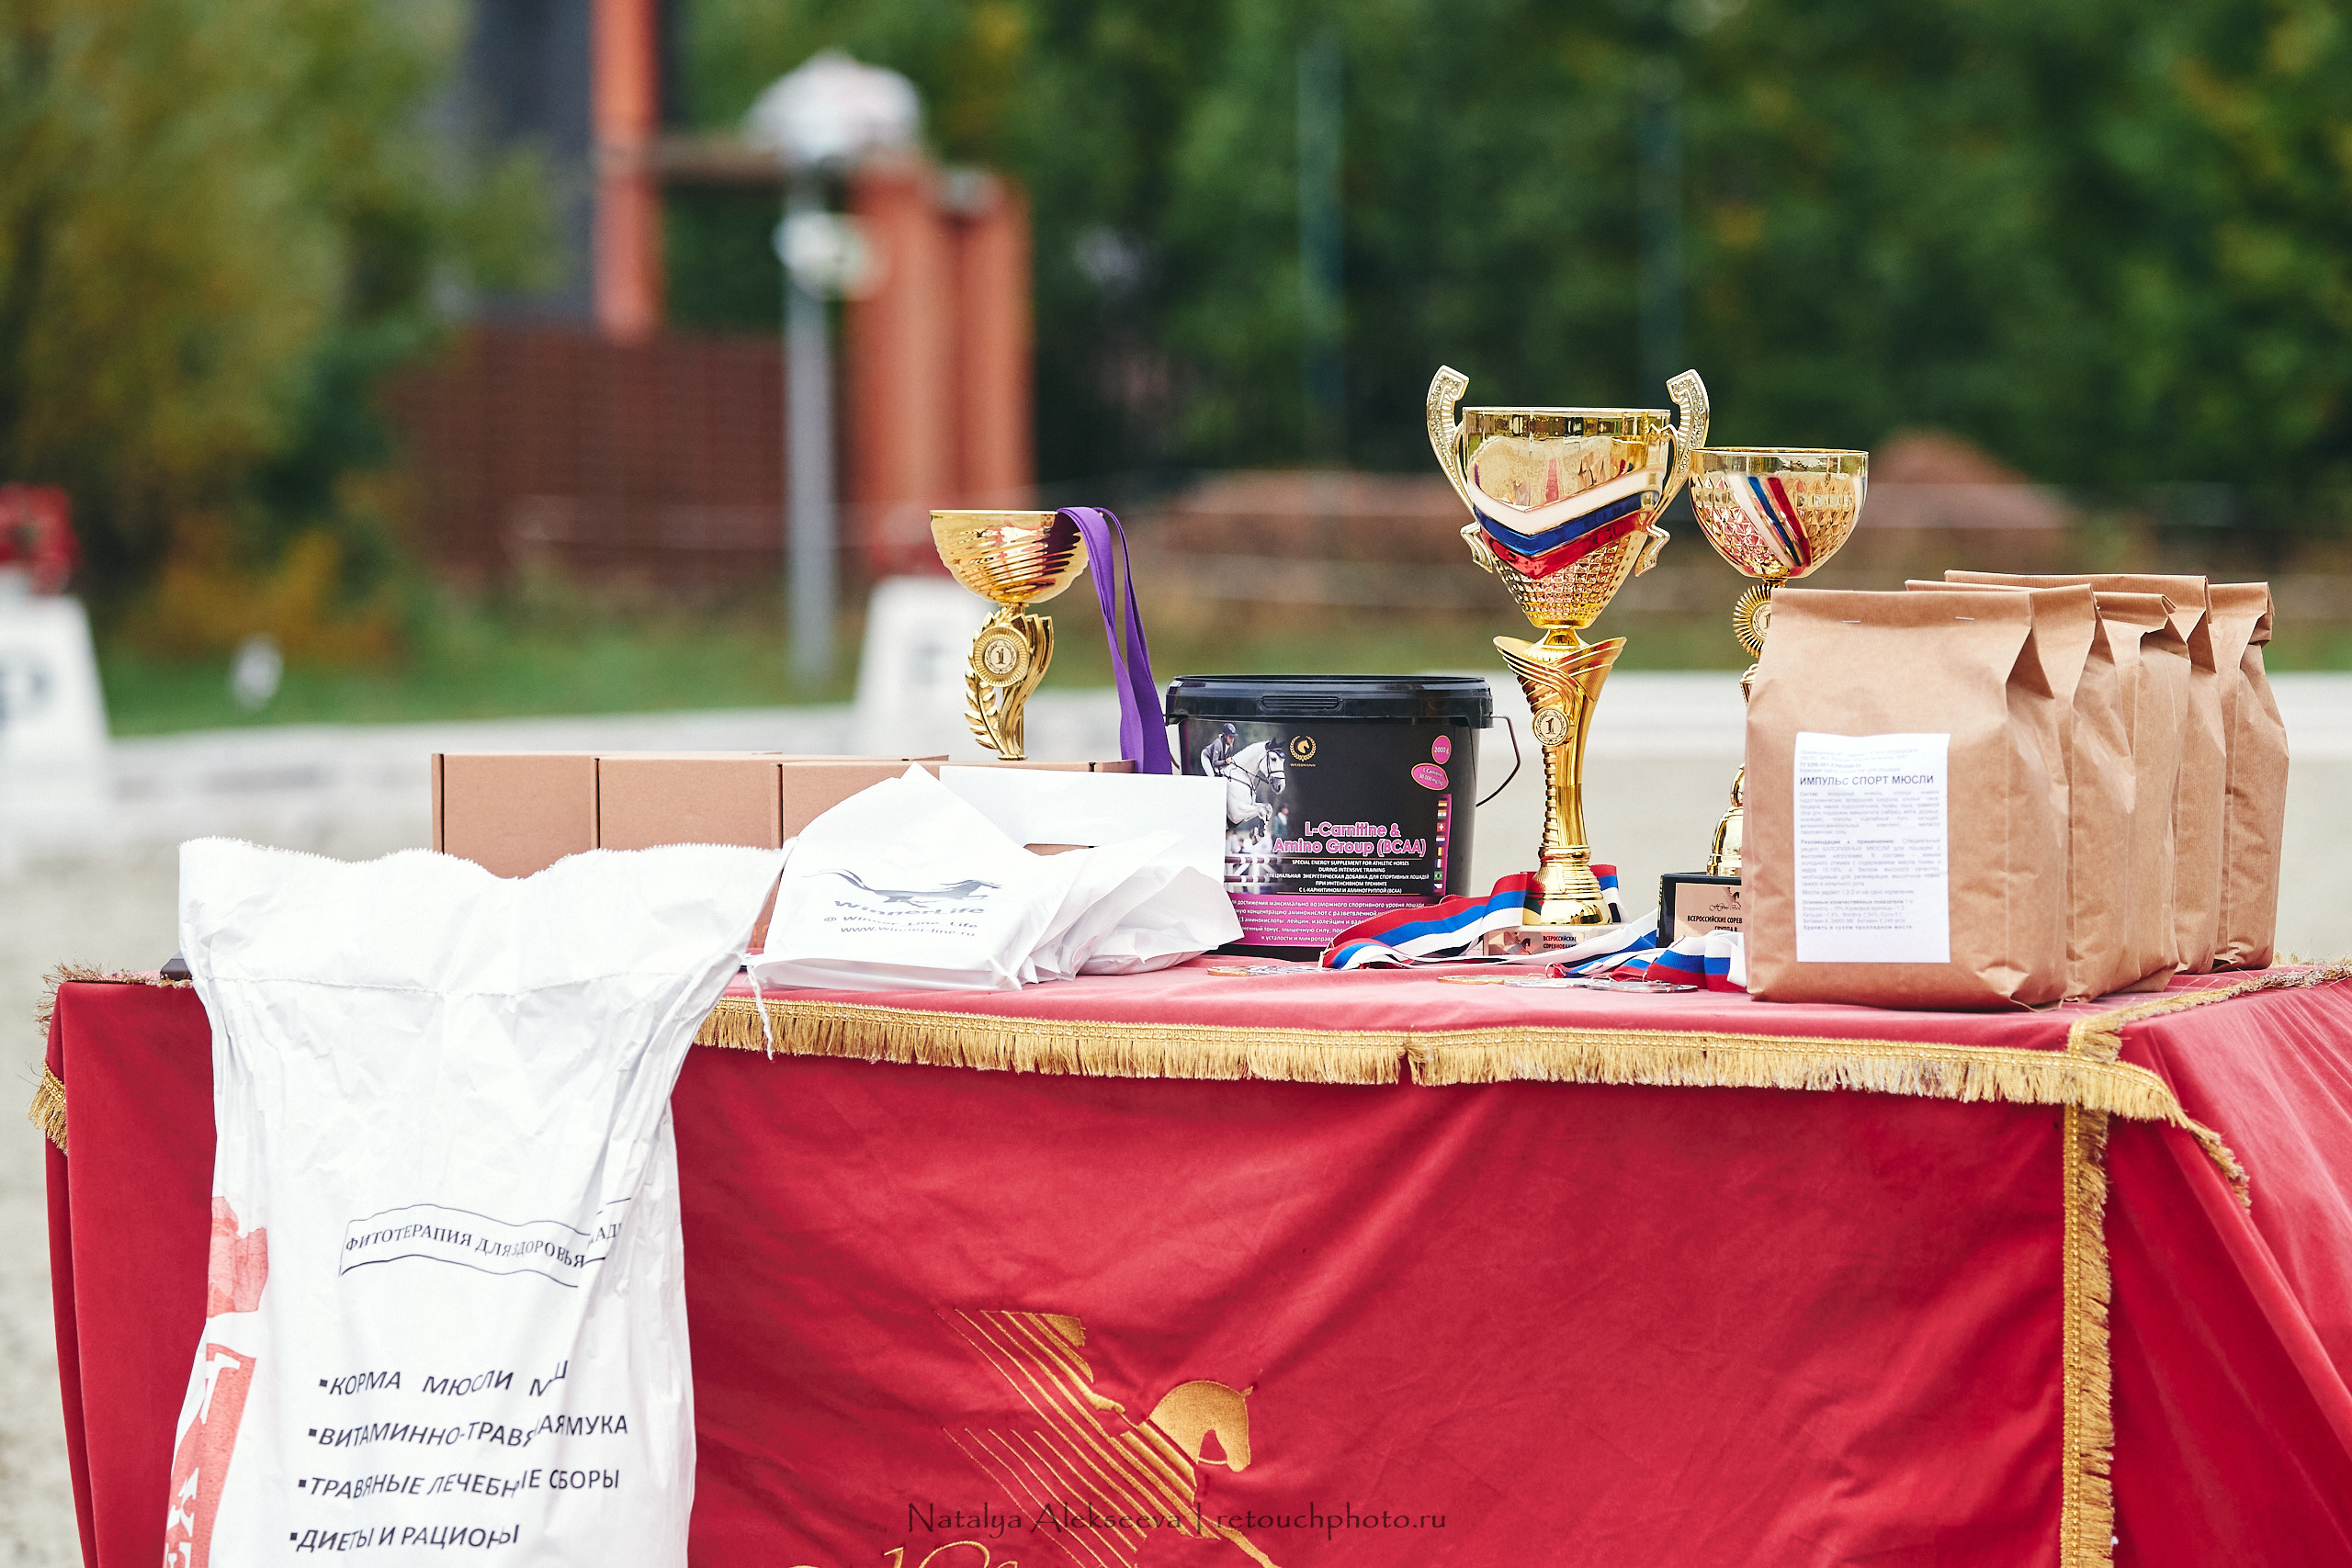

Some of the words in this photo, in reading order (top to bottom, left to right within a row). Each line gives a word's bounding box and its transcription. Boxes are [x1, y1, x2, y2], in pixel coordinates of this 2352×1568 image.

[996, 648, 1005, 664] 1
[1545, 717, 1556, 735] 1
[1800, 776, 1849, 785] ИМПУЛЬС
[1852, 776, 1888, 784] СПОРТ
[1892, 775, 1934, 784] МЮСЛИ
[1305, 821, 1387, 837] L-Carnitine
[1389, 822, 1401, 838] &
[1272, 838, 1323, 853] Amino
[1325, 839, 1374, 857] Group
[1377, 839, 1426, 857] (BCAA)
[834, 900, 985, 916] WinnerLife
[1687, 915, 1727, 923] ВСЕРОССИЙСКИЕ
[345, 1224, 472, 1252] ФИТОТЕРАПИЯ
[329, 1371, 401, 1396] КОРМА
[422, 1369, 514, 1396] МЮСЛИ
[311, 1472, 425, 1499] ТРАВЯНЫЕ
[549, 1469, 619, 1489] СБОРЫ
[296, 1528, 375, 1552] ДИЕТЫ
[378, 1526, 396, 1546] И
